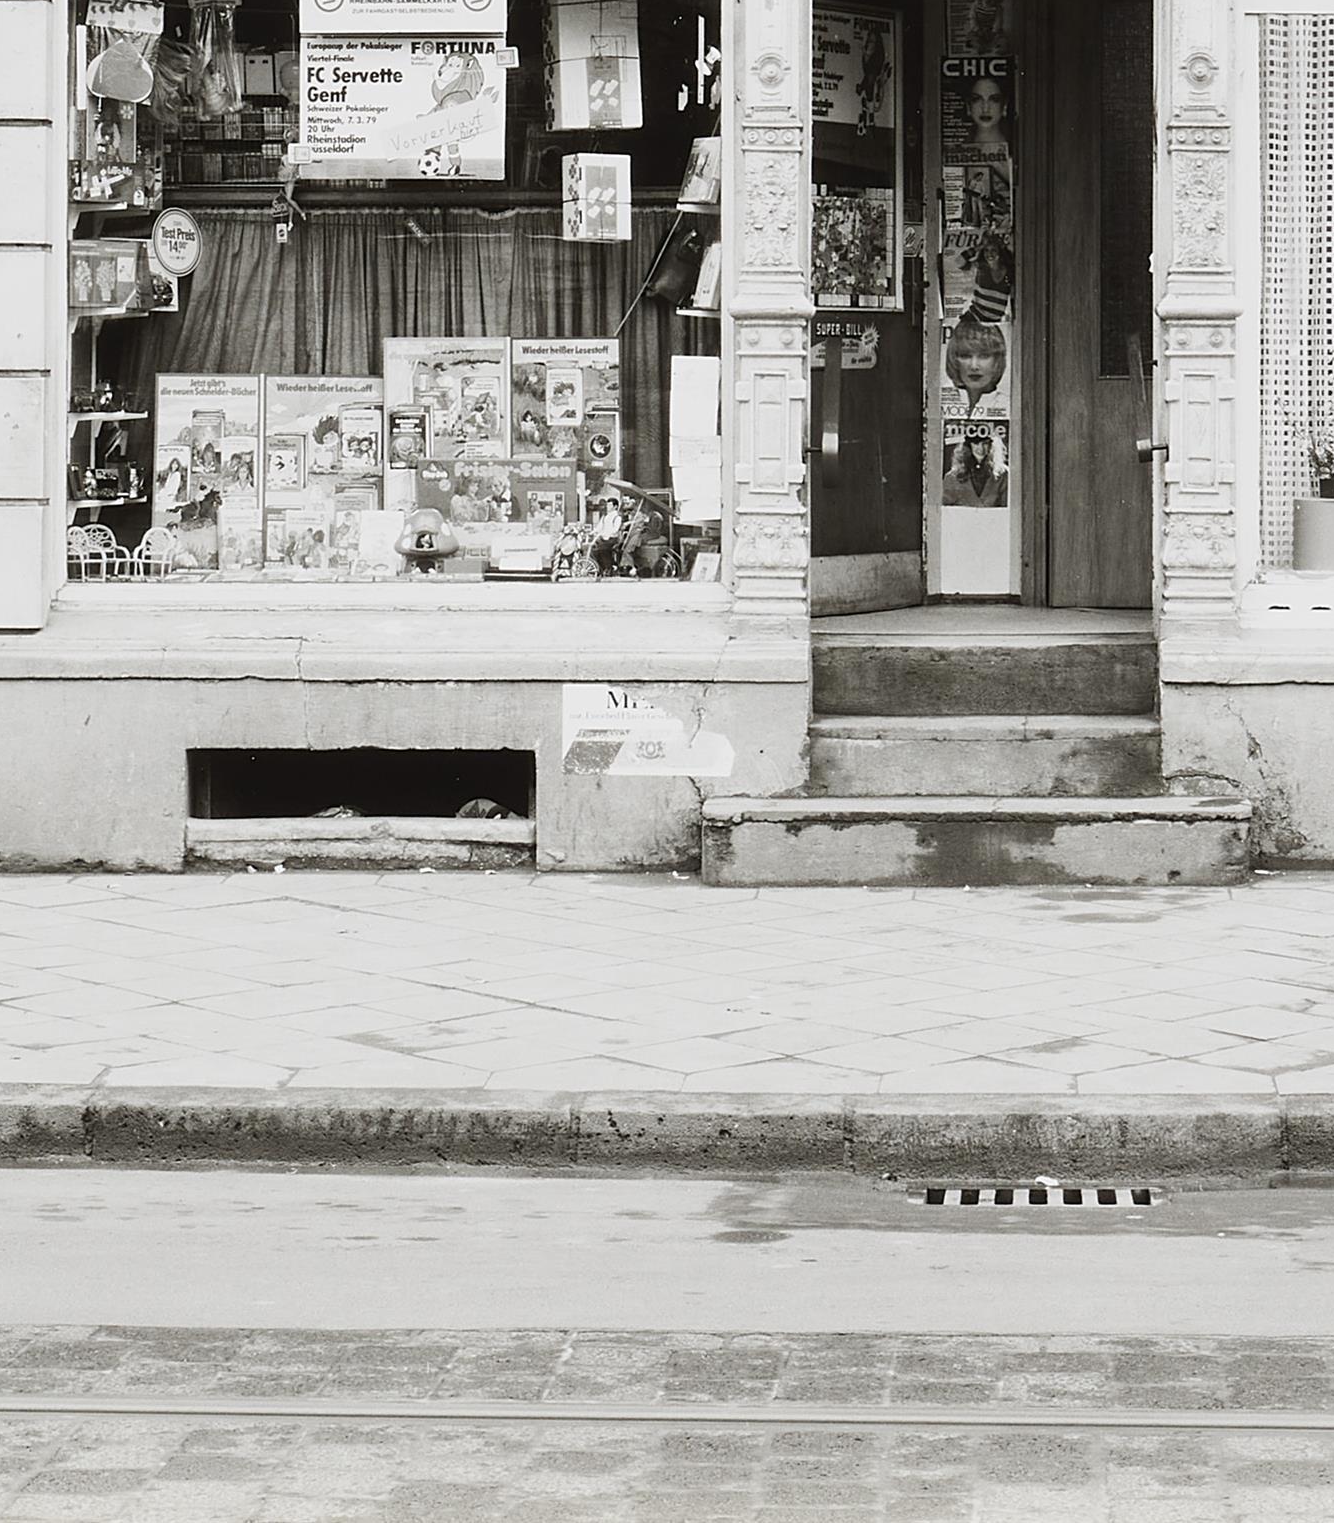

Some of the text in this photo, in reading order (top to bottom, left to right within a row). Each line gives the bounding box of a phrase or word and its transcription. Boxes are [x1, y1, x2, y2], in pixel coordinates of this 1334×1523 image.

[361, 42, 403, 51] Pokalsieger
[307, 54, 354, 62] Viertel-Finale
[943, 59, 1007, 76] CHIC
[307, 67, 403, 83] FC Servette
[307, 86, 347, 103] Genf
[346, 105, 389, 114] Pokalsieger
[307, 125, 335, 133] 20 Uhr
[307, 135, 366, 144] Rheinstadion
[161, 226, 196, 241] Test Preis
[522, 346, 609, 355] Wieder heißer Lesestoff
[160, 388, 172, 396] die
[276, 383, 306, 393] Wieder
[308, 383, 335, 393] heißer
[945, 421, 1007, 438] nicole
